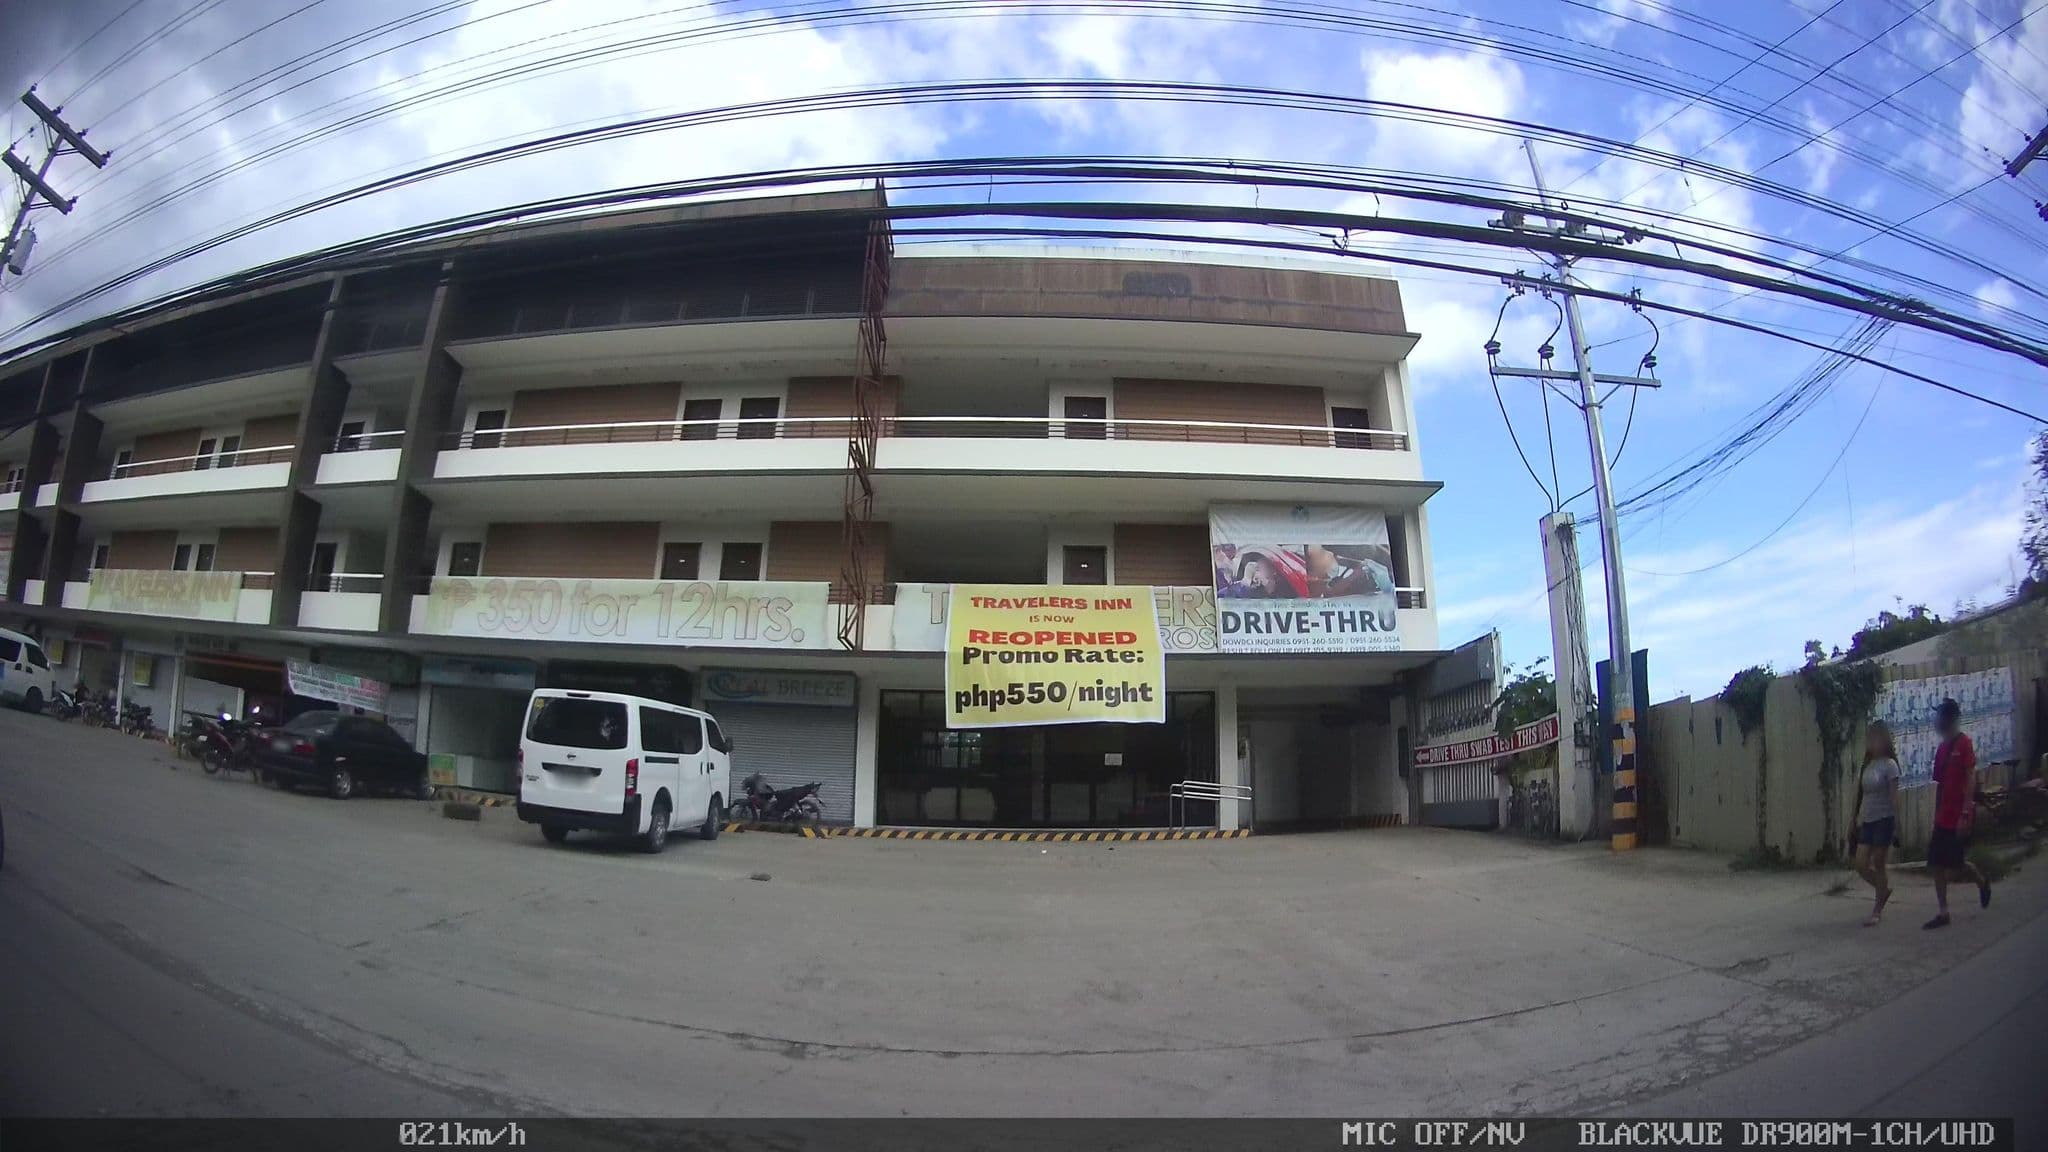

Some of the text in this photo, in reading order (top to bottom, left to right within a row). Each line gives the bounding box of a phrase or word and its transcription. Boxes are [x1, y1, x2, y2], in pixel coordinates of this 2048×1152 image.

[568, 579, 640, 636] for
[653, 581, 805, 642] 12hrs.
[971, 597, 1132, 610] TRAVELERS INN
[1029, 615, 1075, 624] IS NOW
[1221, 610, 1396, 634] DRIVE-THRU
[968, 629, 1137, 646] REOPENED
[963, 646, 1144, 665] Promo Rate:
[955, 679, 1153, 713] php550/night
[1429, 748, 1449, 763] DRIVE
[1450, 743, 1469, 760] THRU
[1470, 738, 1493, 757] SWAB
[1517, 727, 1537, 748] THIS
